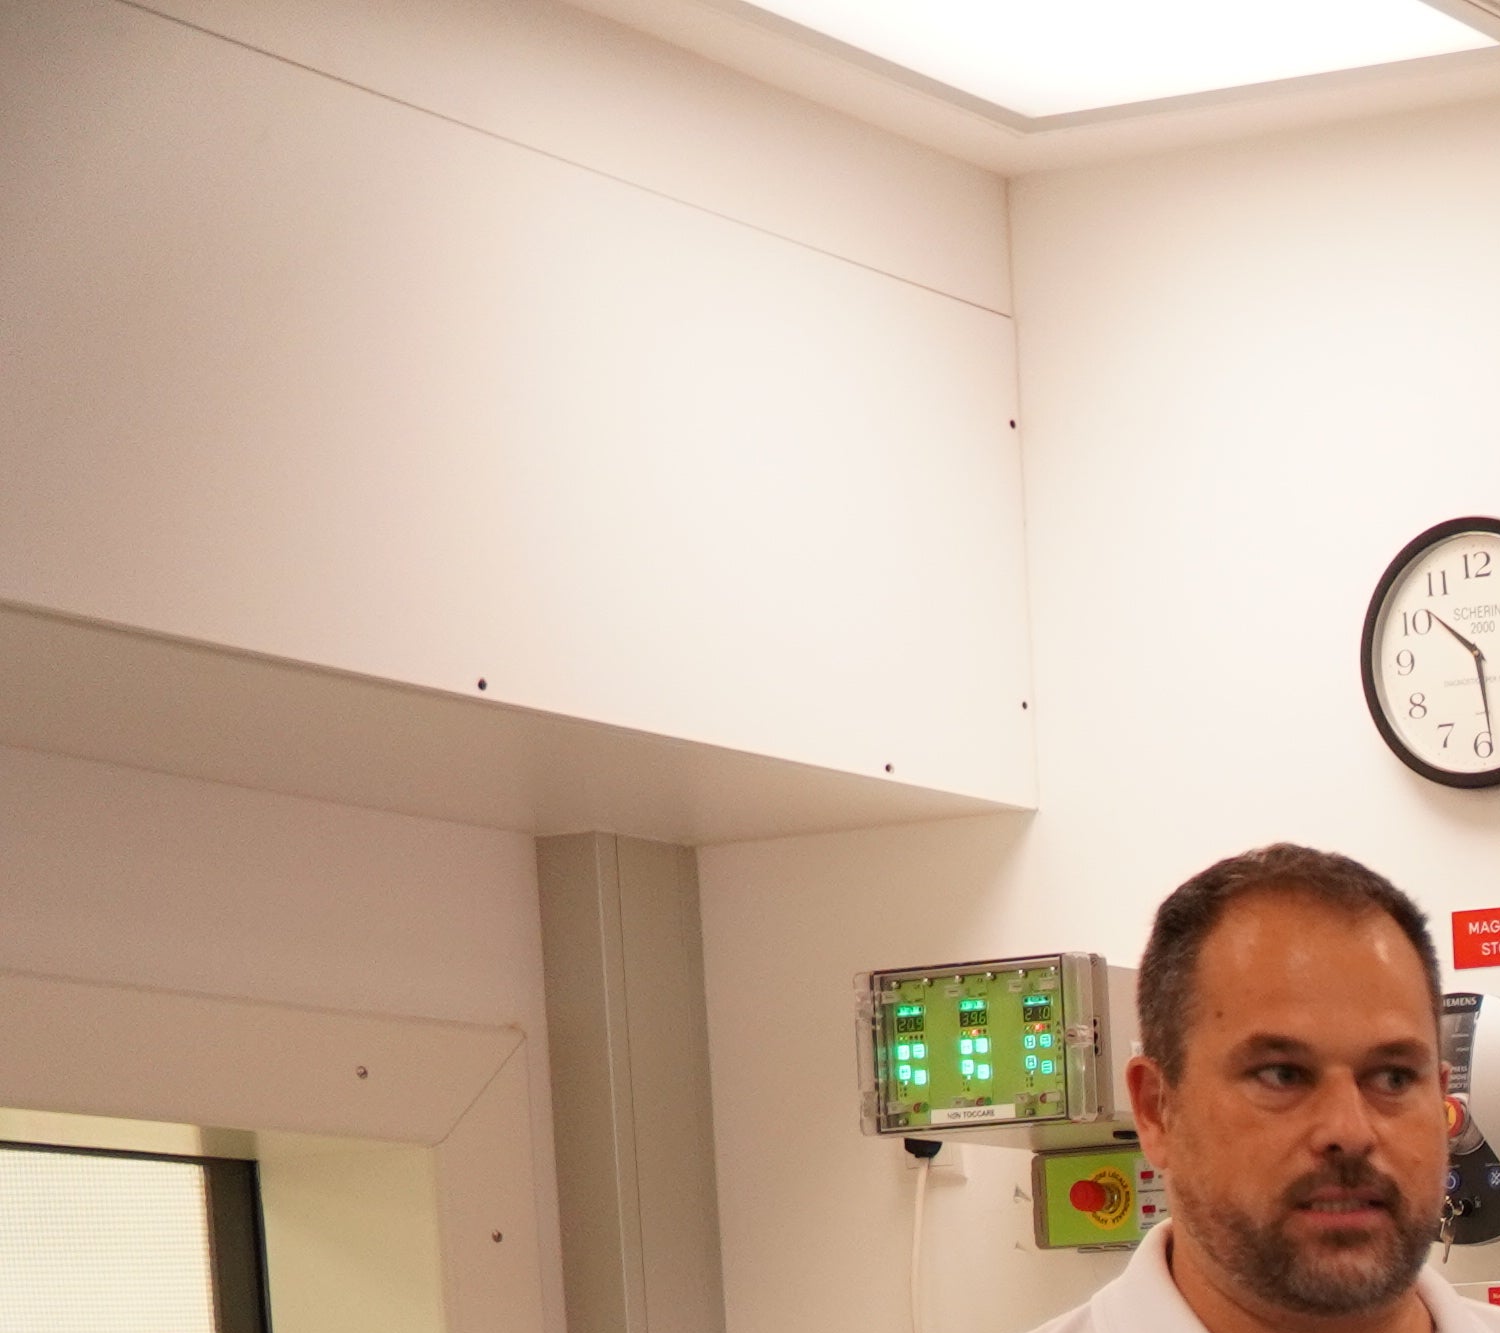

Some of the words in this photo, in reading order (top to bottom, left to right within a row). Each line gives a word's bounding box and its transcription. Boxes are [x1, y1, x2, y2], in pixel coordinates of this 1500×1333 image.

[1463, 551, 1493, 580] 12
[1426, 570, 1449, 597] 11
[1402, 608, 1434, 637] 10
[1470, 620, 1496, 635] 2000
[1396, 649, 1415, 676] 9
[1408, 692, 1428, 719] 8
[1437, 722, 1455, 749] 7
[1473, 731, 1495, 758] 6
[1442, 996, 1478, 1008] IEMENS
[962, 1109, 996, 1119] TOCCARE
